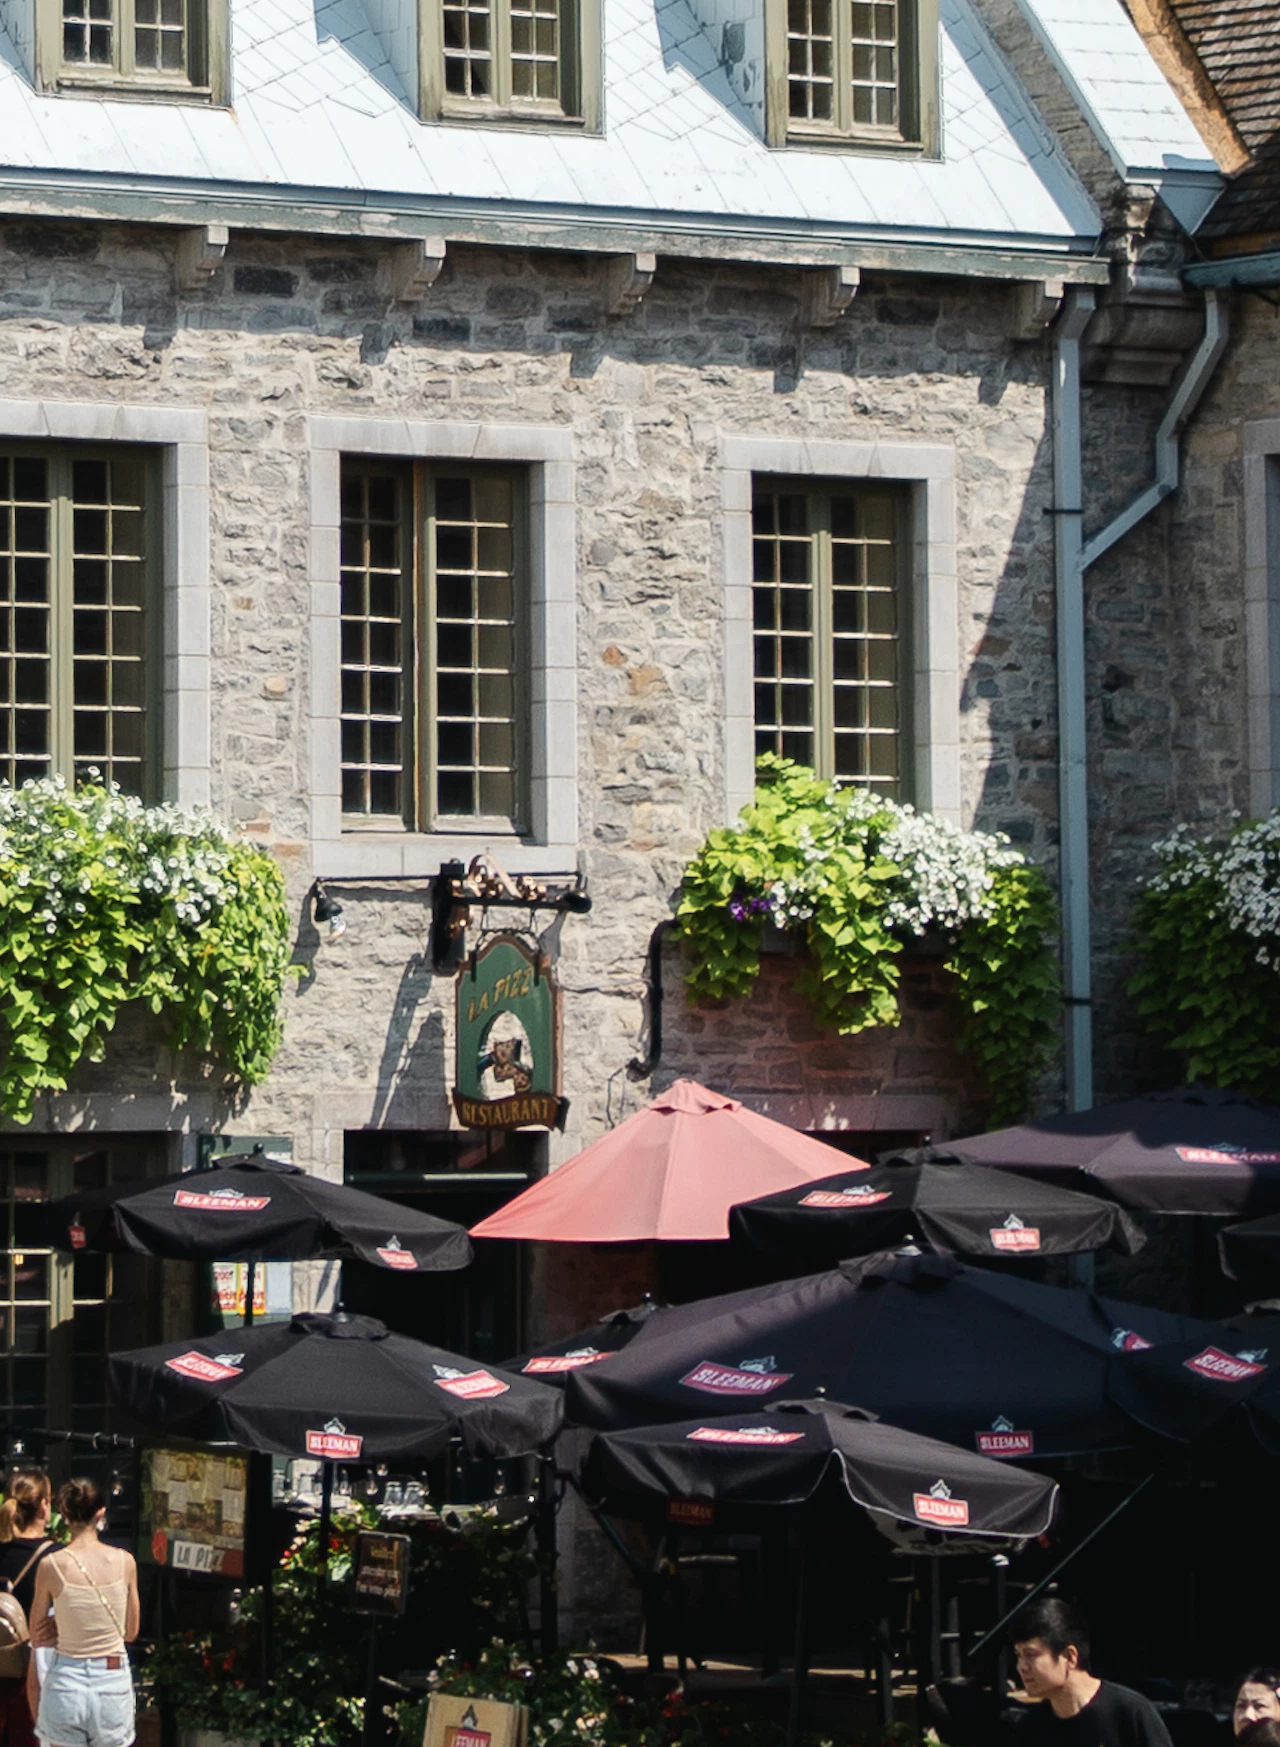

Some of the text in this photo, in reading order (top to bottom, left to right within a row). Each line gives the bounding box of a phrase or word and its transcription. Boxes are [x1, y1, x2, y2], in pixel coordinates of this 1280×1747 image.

[467, 967, 535, 1023] LA PIZZ
[462, 1098, 550, 1127] RESTAURANT
[1193, 1353, 1257, 1379] SLEEMAN
[692, 1369, 778, 1393] SLEEMAN
[979, 1436, 1030, 1451] SLEEMAN
[177, 1545, 191, 1564] LA
